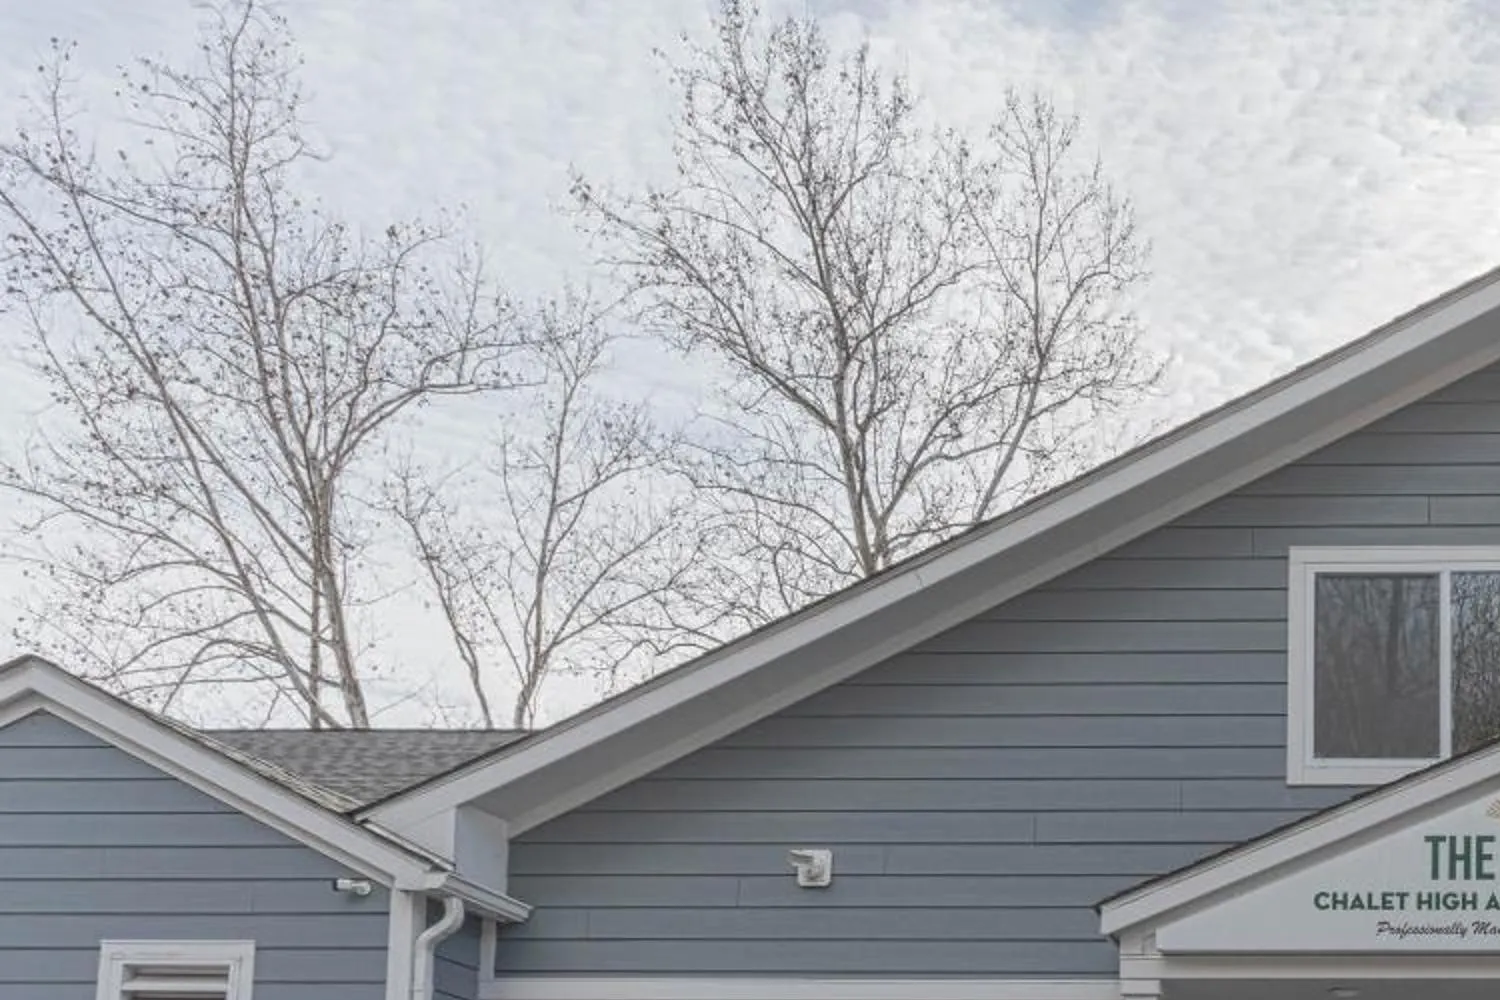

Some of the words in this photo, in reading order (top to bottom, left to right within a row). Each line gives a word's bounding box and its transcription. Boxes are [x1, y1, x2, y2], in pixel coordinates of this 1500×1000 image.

[1424, 835, 1496, 881] THE
[1313, 891, 1410, 911] CHALET
[1416, 891, 1478, 911] HIGH
[1376, 920, 1469, 939] Professionally
